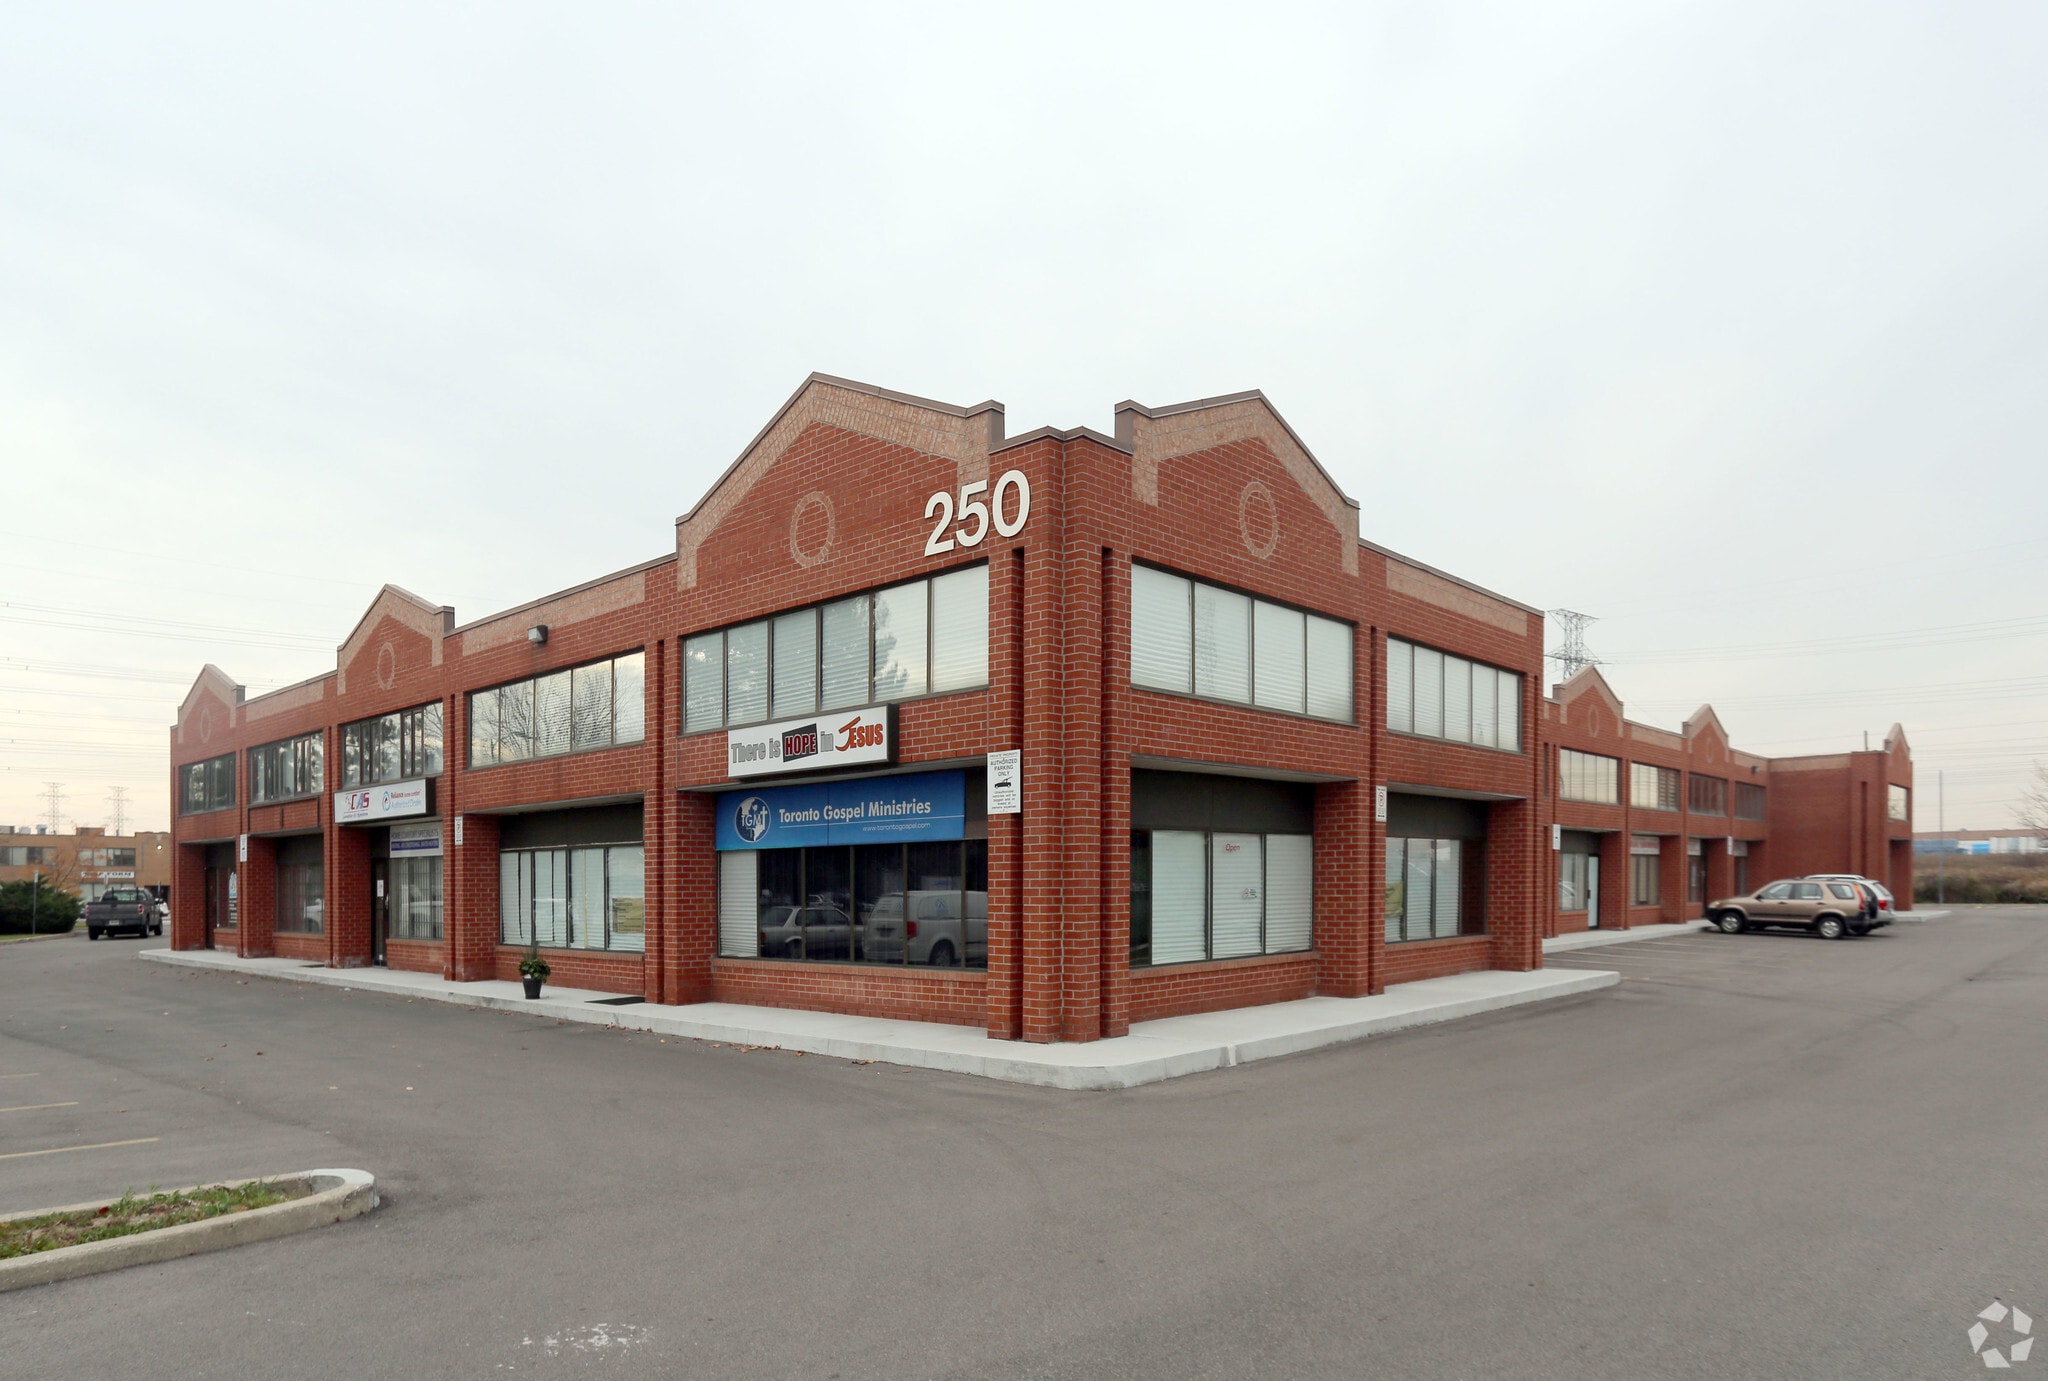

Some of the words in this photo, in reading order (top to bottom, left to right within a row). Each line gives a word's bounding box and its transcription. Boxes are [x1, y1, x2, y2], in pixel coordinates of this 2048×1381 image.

[924, 469, 1030, 557] 250
[731, 741, 766, 763] There
[769, 738, 781, 759] is
[785, 733, 816, 756] HOPE
[820, 731, 834, 752] in
[835, 716, 884, 751] JESUS
[990, 758, 1018, 766] AUTHORIZED
[779, 808, 819, 823] Toronto
[823, 801, 864, 823] Gospel
[868, 797, 931, 817] Ministries
[862, 822, 931, 832] www.torontogospel.com
[1226, 843, 1240, 853] Open
